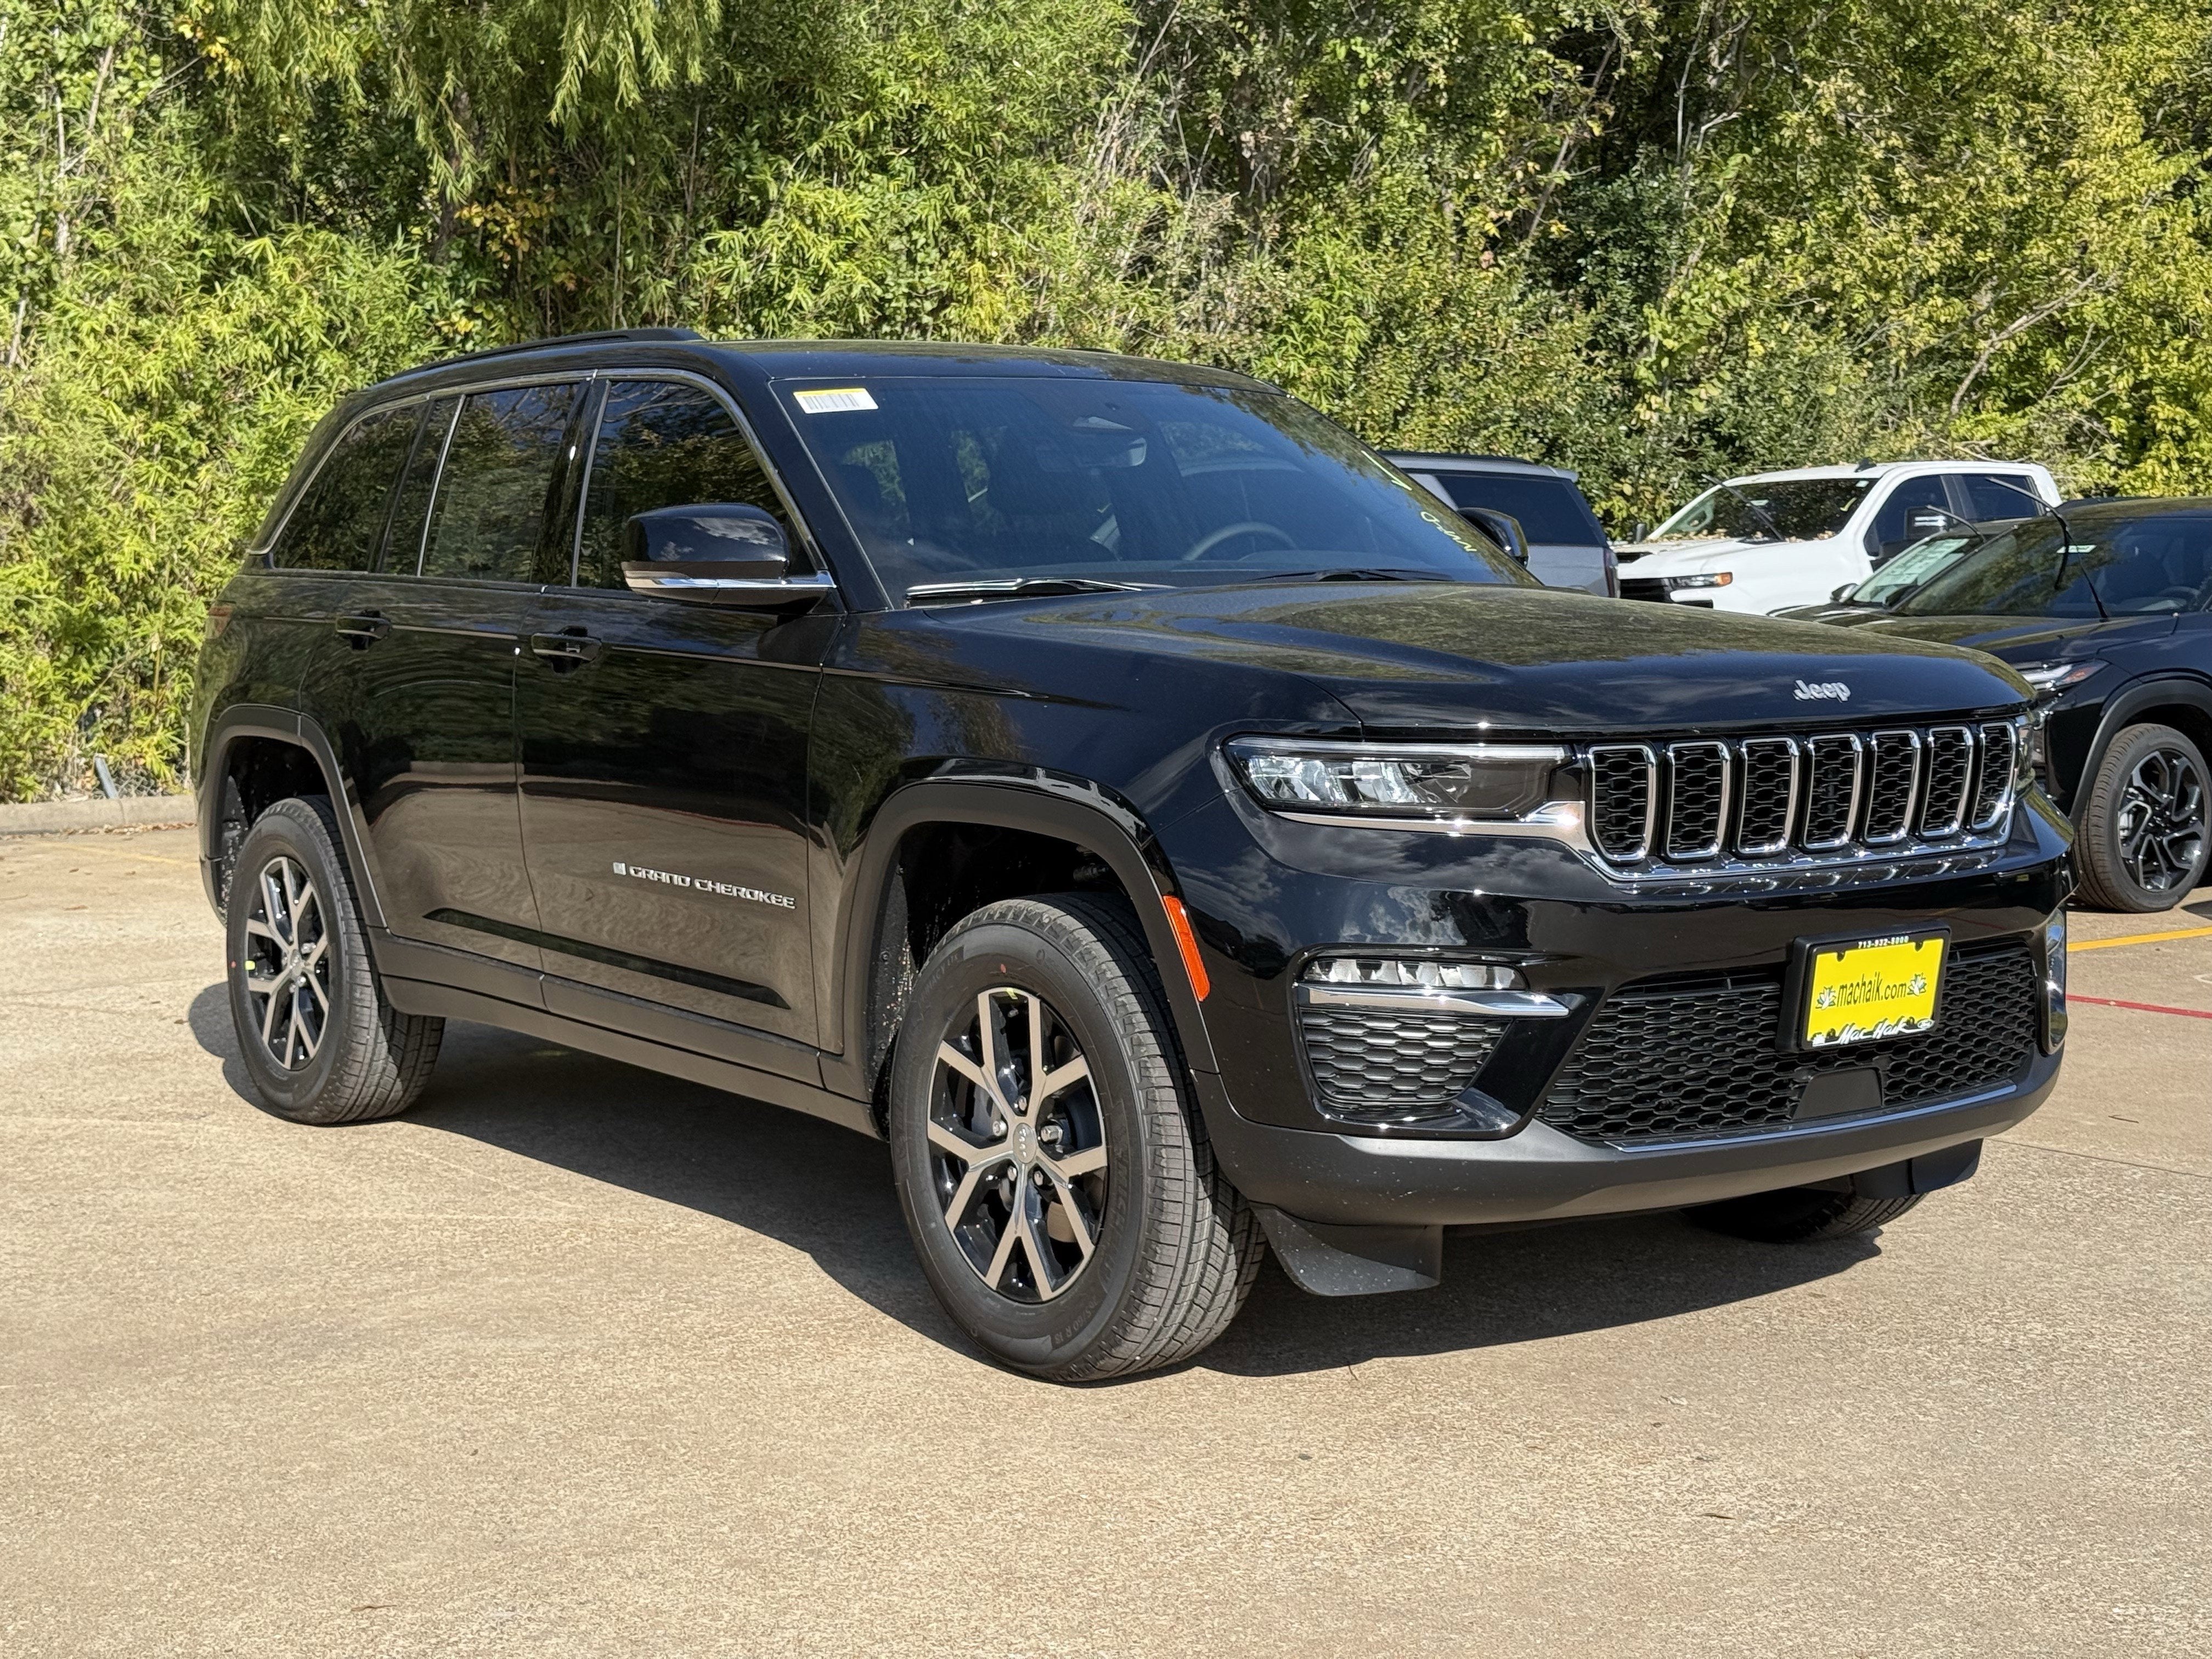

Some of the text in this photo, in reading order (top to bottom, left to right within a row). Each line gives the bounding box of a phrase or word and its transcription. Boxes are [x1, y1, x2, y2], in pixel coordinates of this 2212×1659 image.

[1793, 680, 1851, 702] Jeep
[629, 866, 795, 909] GRAND CHEROKEE
[1836, 972, 1907, 1007] machaik.com
[1838, 1015, 1908, 1045] Mac Haik
